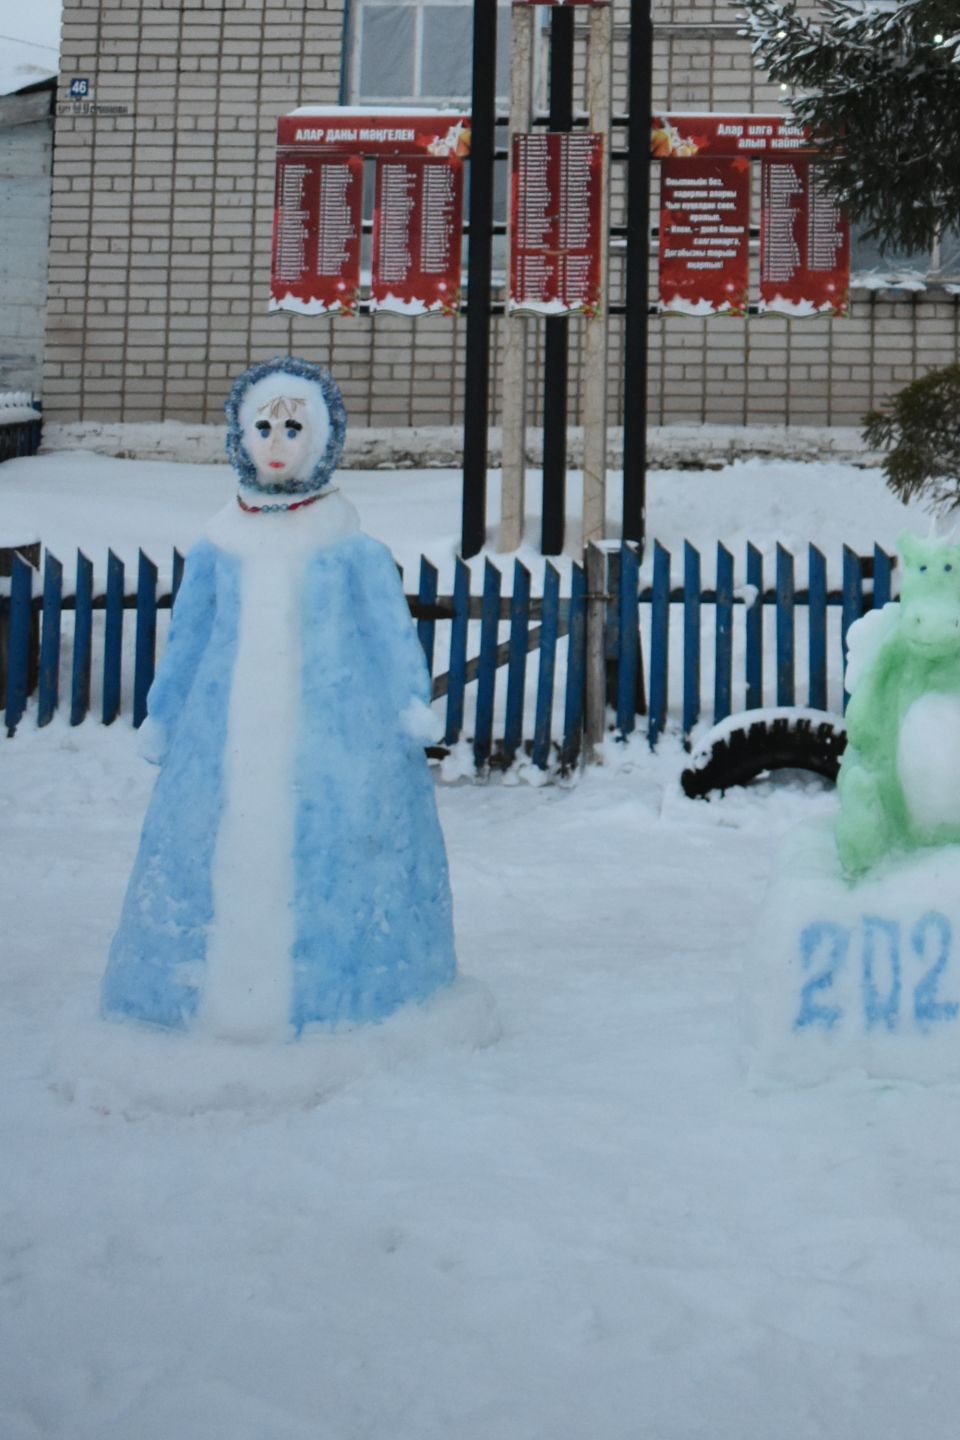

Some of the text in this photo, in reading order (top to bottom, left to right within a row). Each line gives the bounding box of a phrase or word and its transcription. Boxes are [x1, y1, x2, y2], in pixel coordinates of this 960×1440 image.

[71, 80, 87, 94] 46
[295, 129, 324, 141] АЛАР
[325, 129, 358, 142] ДАНЫ
[717, 124, 743, 137] Алар
